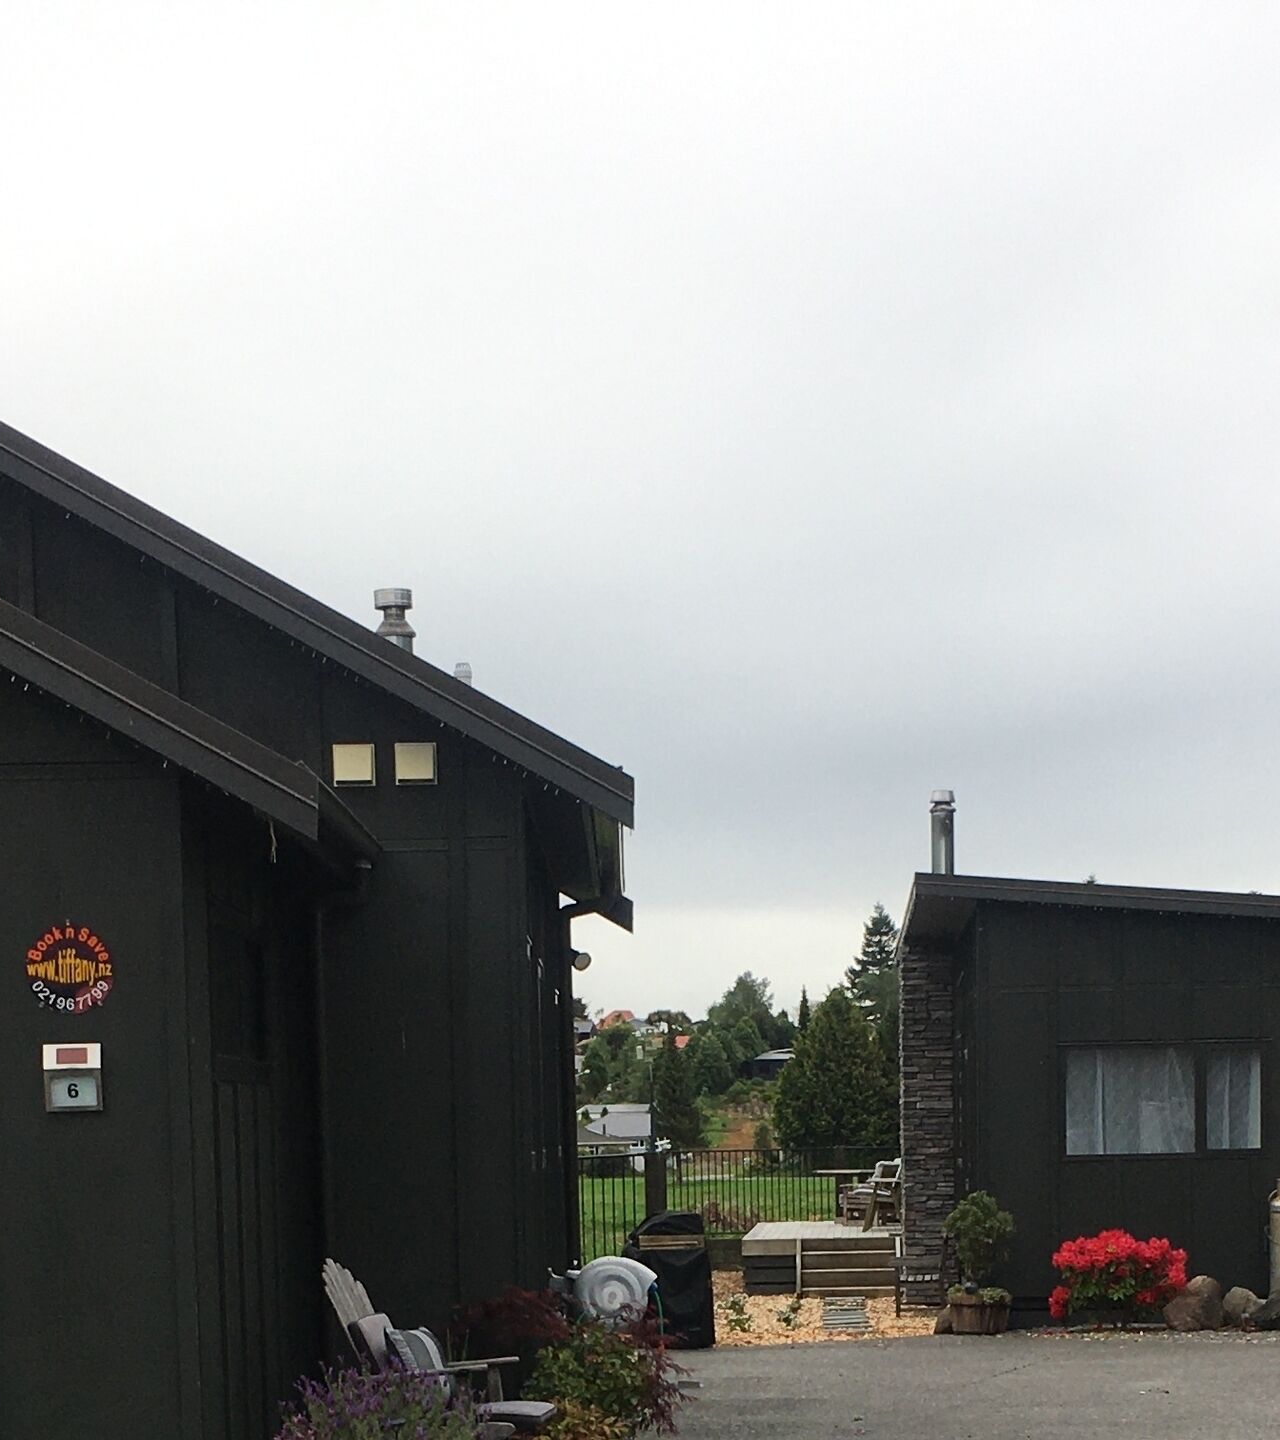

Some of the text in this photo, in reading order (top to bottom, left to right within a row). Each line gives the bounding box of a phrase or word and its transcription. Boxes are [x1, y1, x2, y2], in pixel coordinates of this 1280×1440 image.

[28, 927, 109, 962] Book n Save
[27, 948, 113, 987] www.tiffany.nz
[32, 981, 109, 1011] 021967799
[67, 1083, 79, 1098] 6
